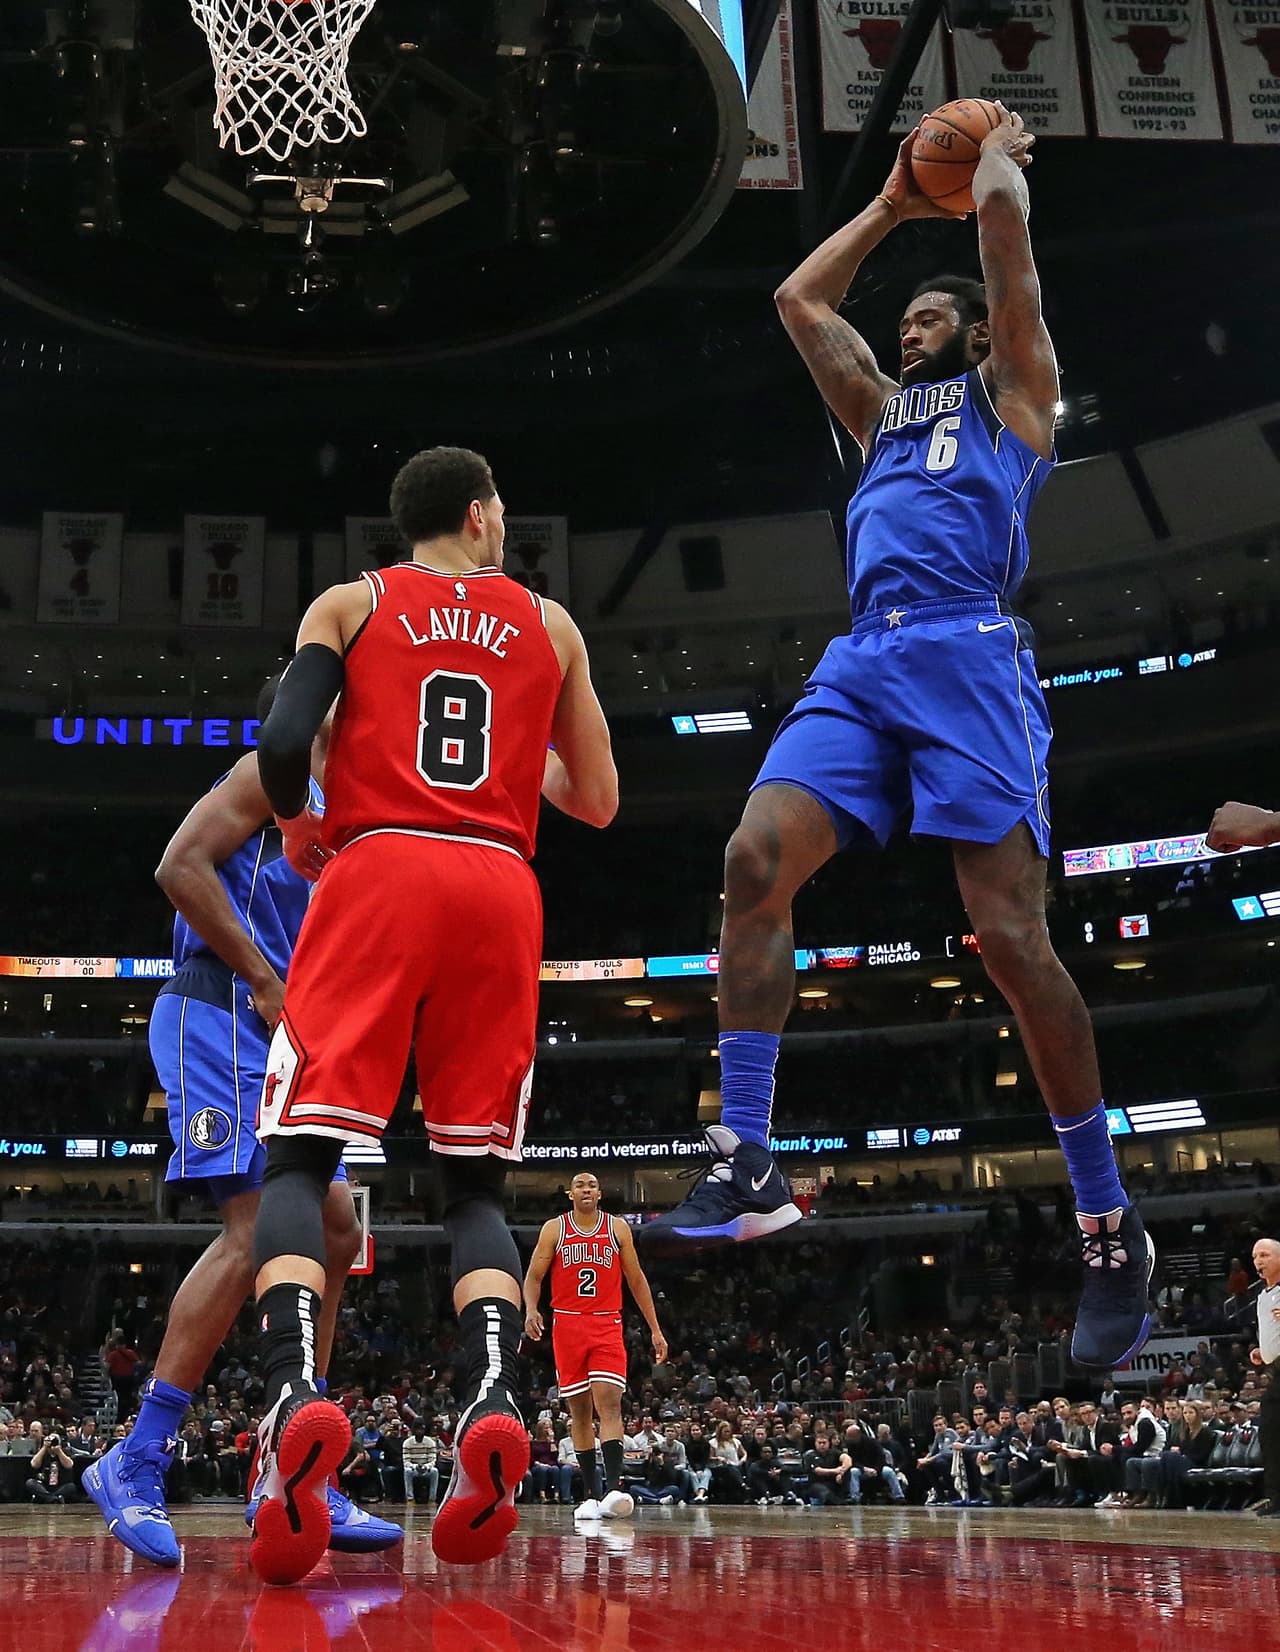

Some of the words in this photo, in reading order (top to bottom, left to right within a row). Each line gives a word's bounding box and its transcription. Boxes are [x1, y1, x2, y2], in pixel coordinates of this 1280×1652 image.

[1116, 8, 1179, 22] BULLS
[1244, 10, 1280, 24] BUL
[991, 73, 1044, 84] EASTERN
[1128, 77, 1180, 87] EASTERN
[980, 87, 1059, 98] CONFERENCE
[1118, 90, 1195, 102] CONFERENCE
[1120, 105, 1197, 117] CHAMPIONS
[1133, 120, 1187, 131] 1992-93
[926, 416, 961, 471] 6
[398, 607, 521, 659] LAVINE
[1193, 649, 1217, 664] AT&T
[1052, 670, 1092, 687] thank
[1093, 667, 1124, 684] you.
[415, 668, 494, 792] 8
[868, 942, 912, 955] DALLAS
[18, 957, 61, 966] TIMEOUTS
[73, 958, 102, 966] FOULS
[594, 960, 622, 968] FOULS
[868, 951, 921, 965] CHICAGO
[35, 967, 42, 976] 7
[82, 967, 94, 976] 00
[133, 959, 176, 976] MAVER
[555, 970, 562, 978] 7
[603, 969, 615, 978] 01
[931, 1128, 962, 1142] AT&T
[11, 1142, 47, 1156] you.
[129, 1143, 158, 1155] AT&T
[521, 1145, 578, 1158] eterans
[581, 1143, 609, 1158] and
[612, 1143, 669, 1157] veteran
[770, 1135, 812, 1151] hank
[813, 1137, 848, 1153] you.
[562, 1243, 613, 1269] BULLS
[577, 1268, 597, 1297] 2
